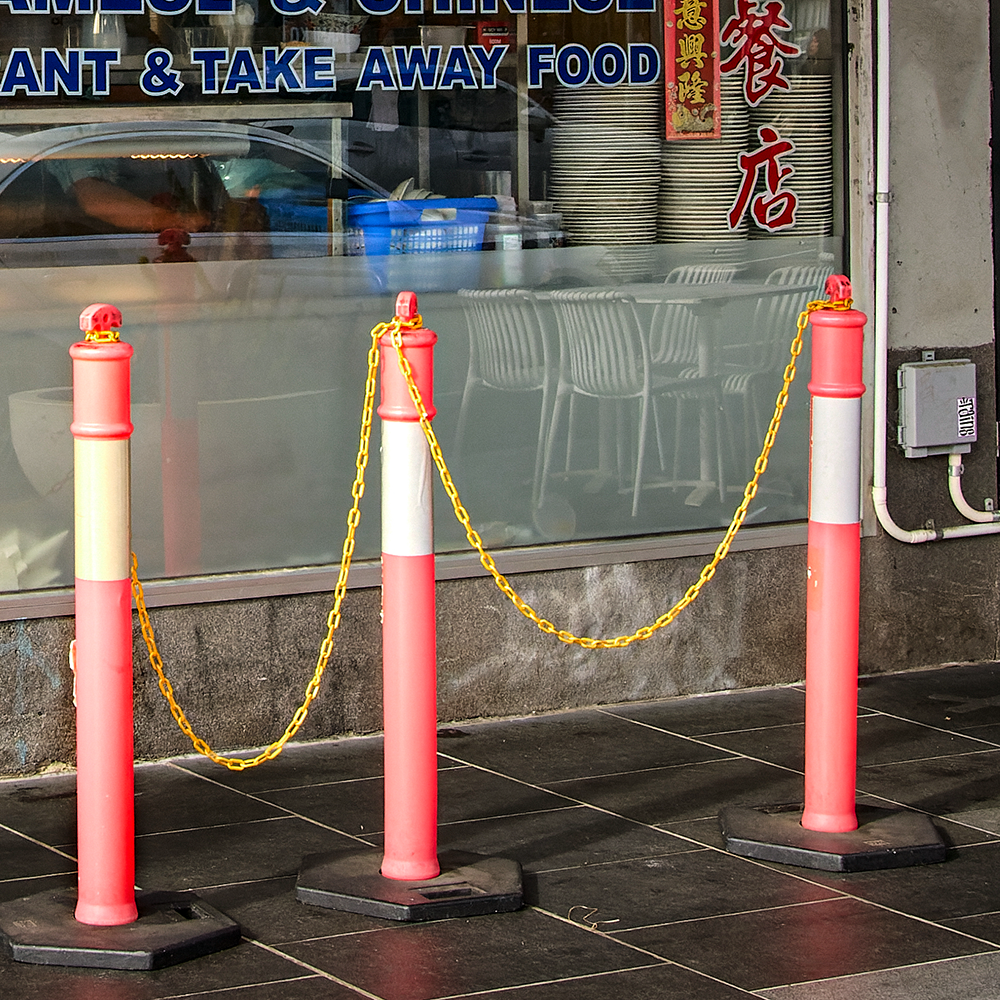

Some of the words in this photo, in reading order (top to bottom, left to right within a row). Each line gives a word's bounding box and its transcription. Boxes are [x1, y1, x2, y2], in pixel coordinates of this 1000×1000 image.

[139, 48, 184, 97] &
[190, 46, 337, 94] TAKE
[356, 44, 510, 92] AWAY
[527, 42, 661, 89] FOOD
